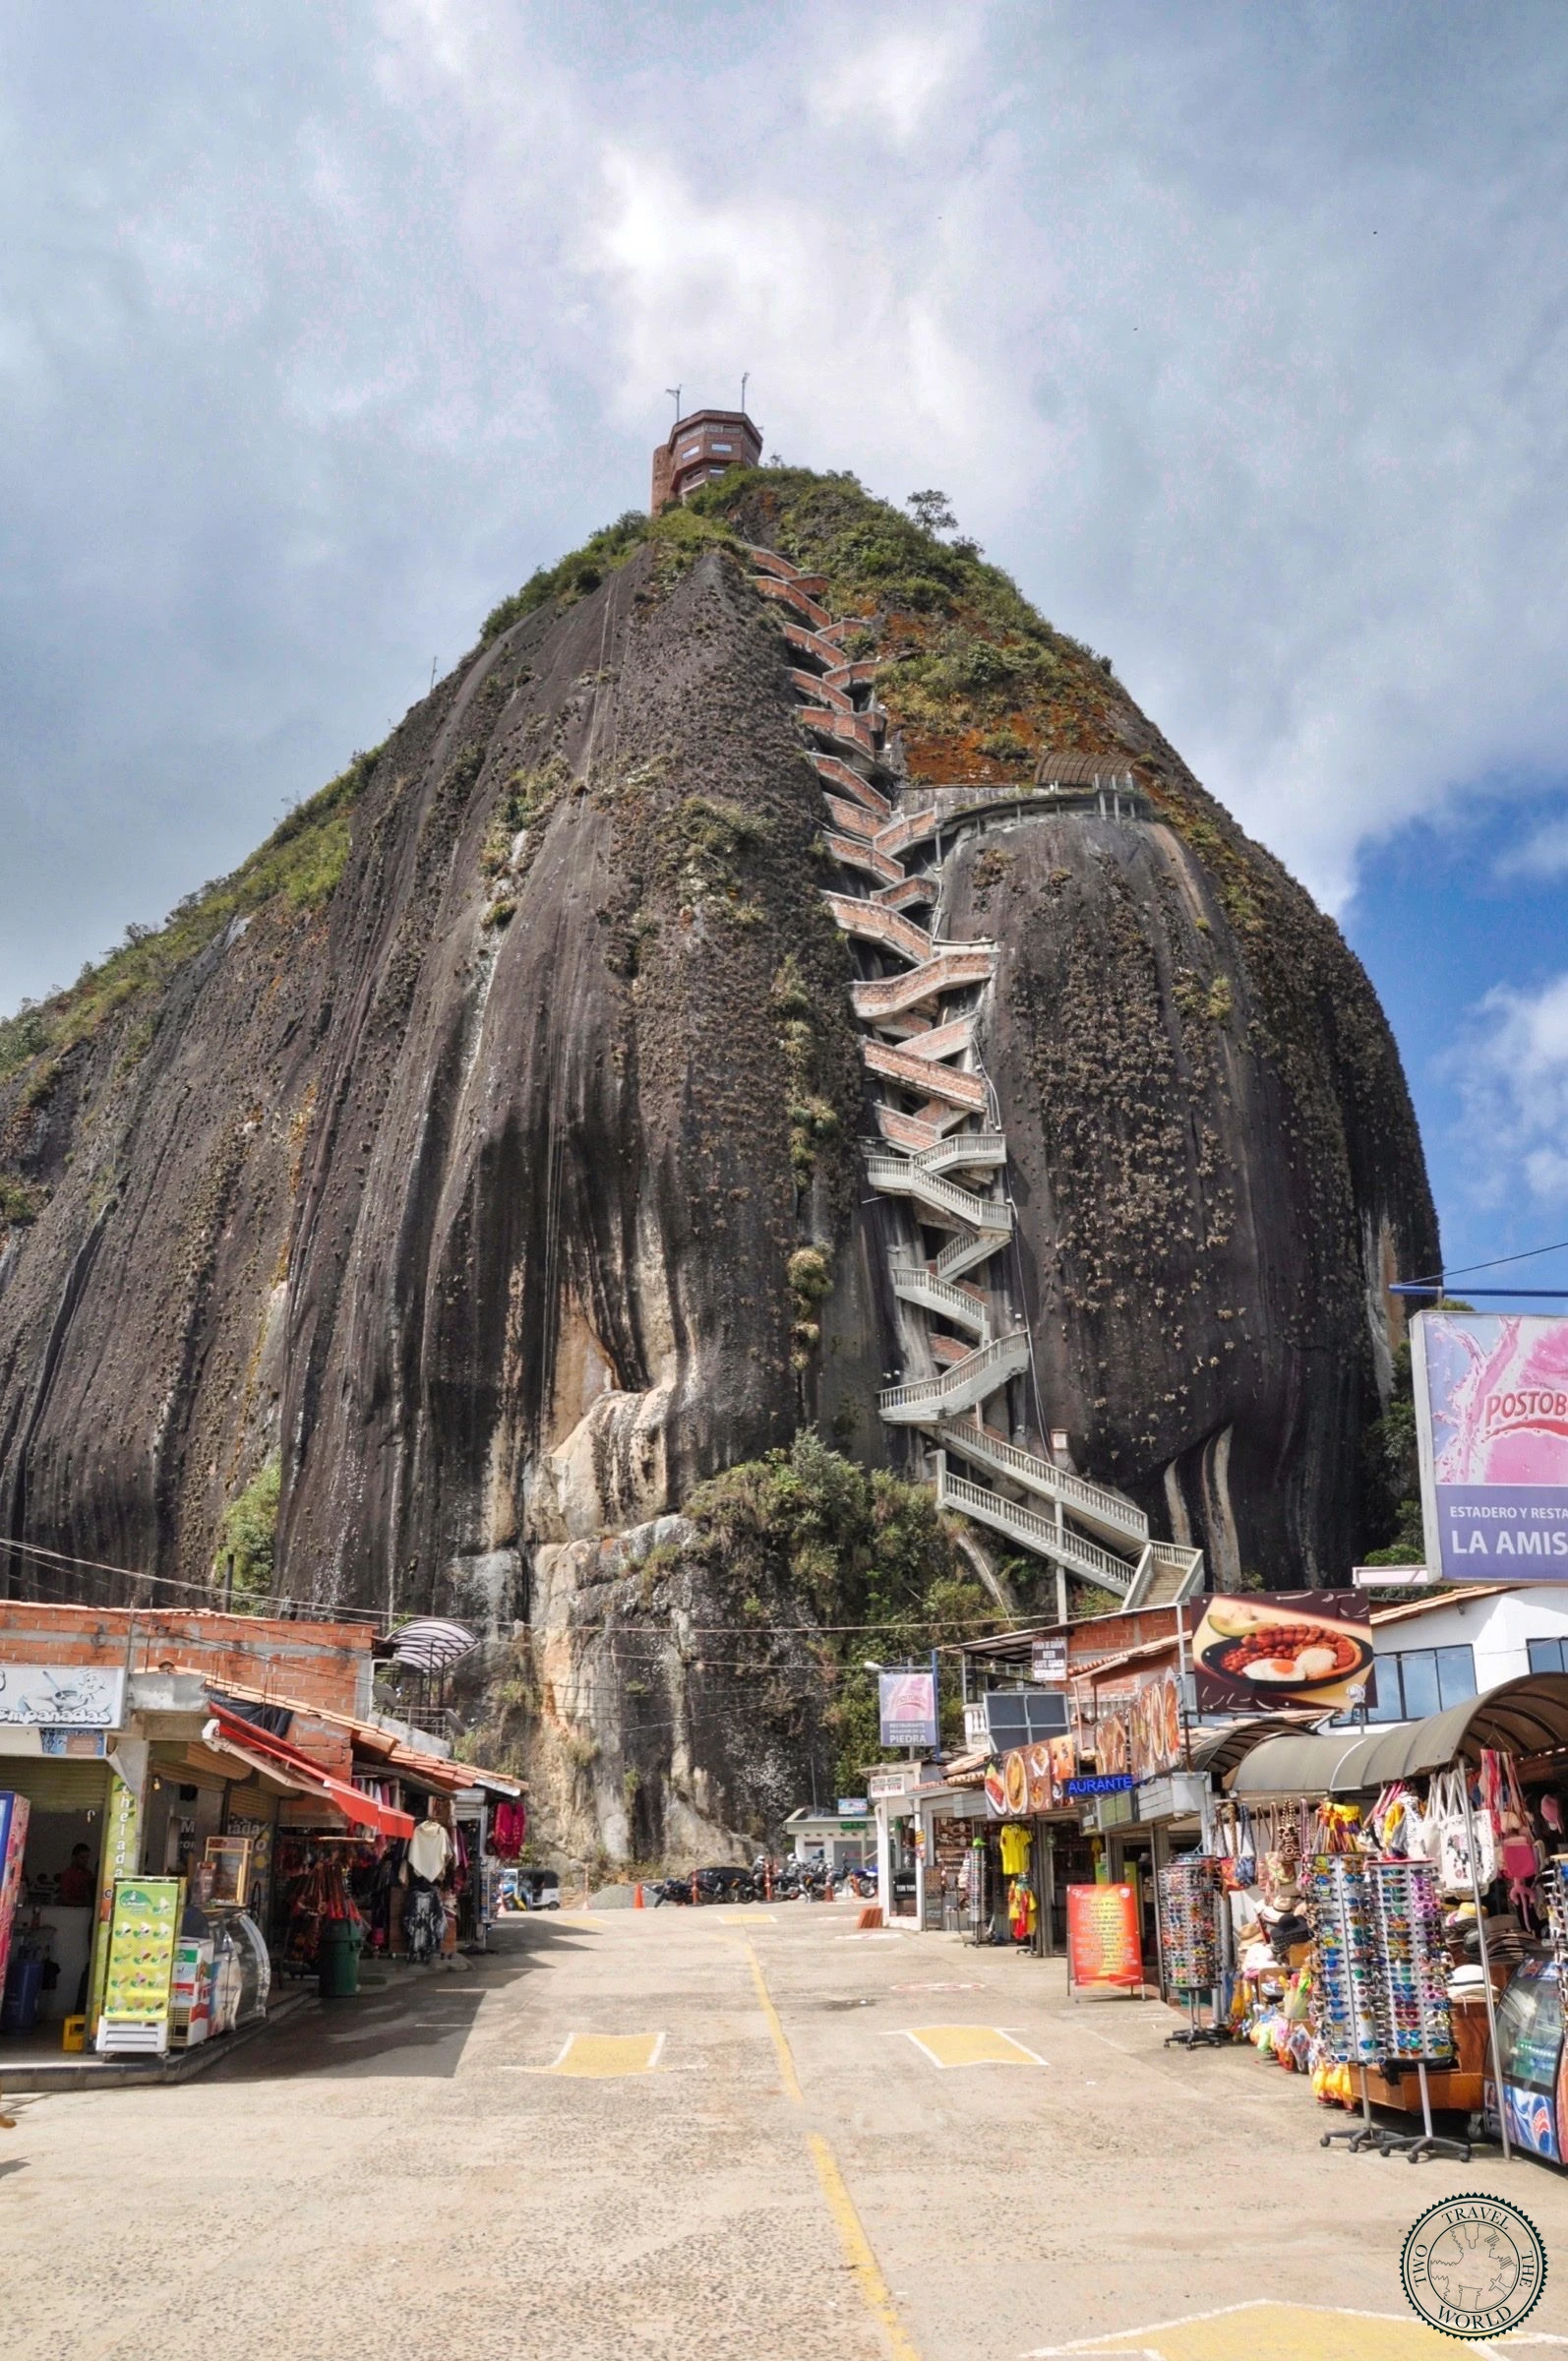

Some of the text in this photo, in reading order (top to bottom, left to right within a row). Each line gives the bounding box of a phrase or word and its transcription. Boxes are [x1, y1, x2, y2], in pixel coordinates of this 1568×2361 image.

[1450, 1506, 1517, 1519] ESTADERO
[1519, 1507, 1528, 1519] Y
[1451, 1530, 1568, 1556] LA AMIS
[889, 1734, 928, 1744] PIEDRA
[1067, 1776, 1132, 1794] AURANTE
